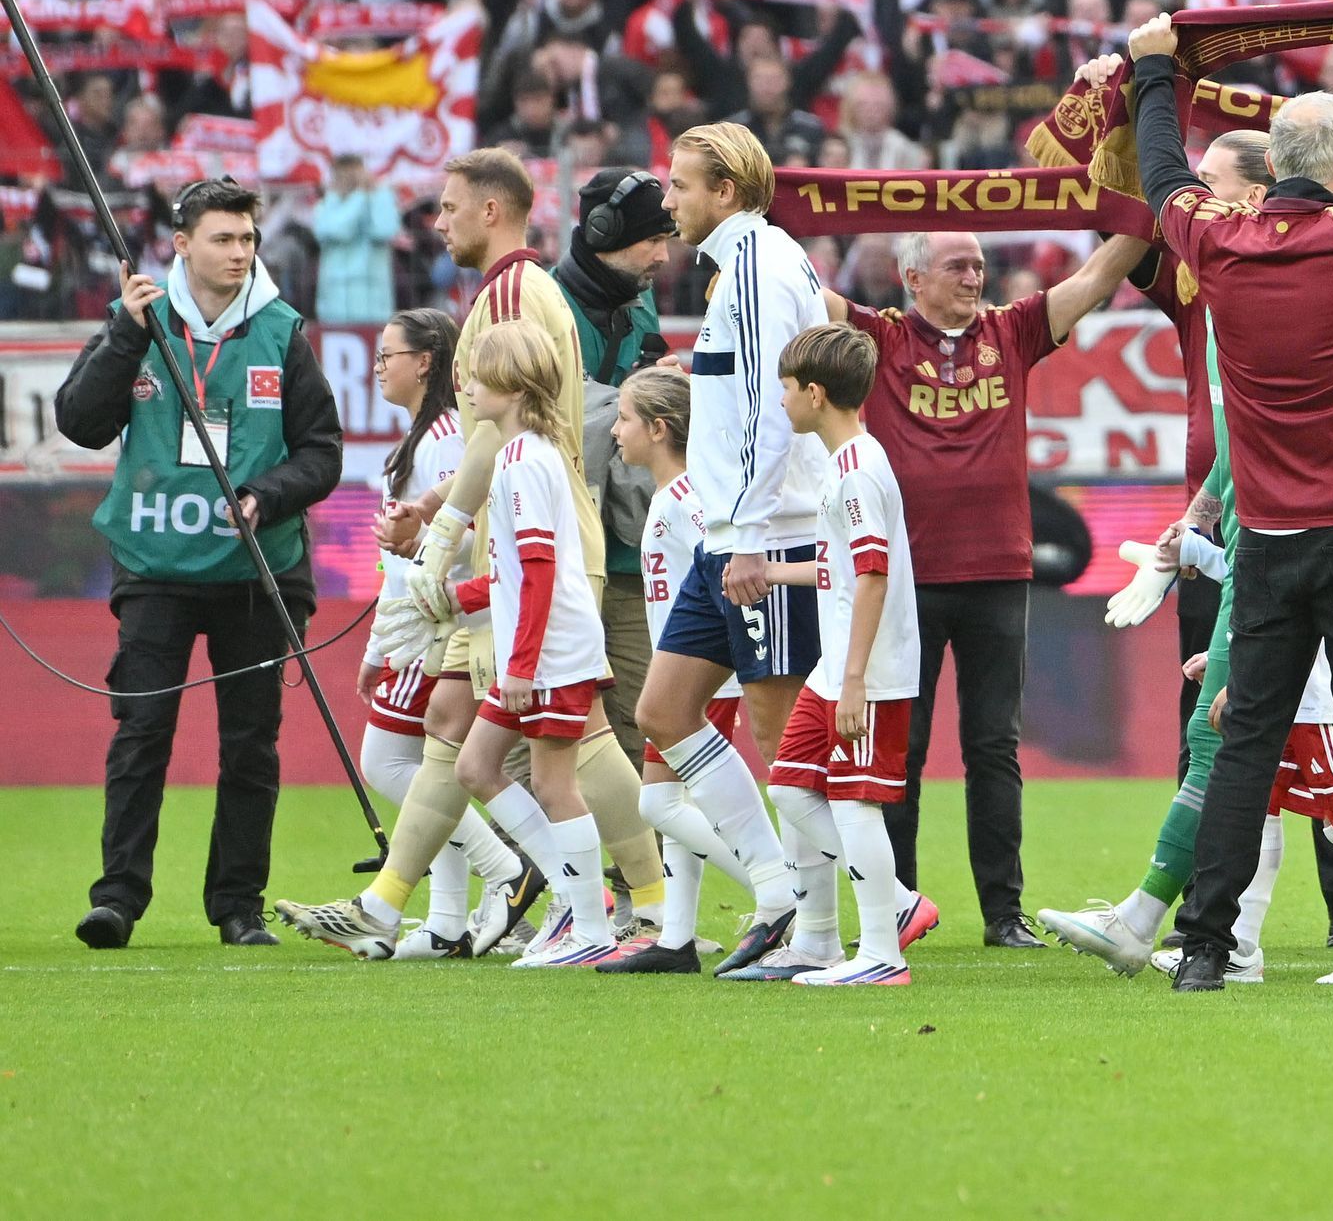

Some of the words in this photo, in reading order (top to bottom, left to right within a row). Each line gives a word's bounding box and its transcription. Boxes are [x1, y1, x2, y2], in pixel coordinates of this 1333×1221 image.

[798, 183, 837, 213] 1.
[846, 180, 926, 212] FC
[936, 170, 1100, 211] KÖLN
[909, 375, 1011, 419] REWE
[130, 491, 241, 537] HOS
[845, 499, 857, 527] CLUB
[852, 497, 863, 525] PÄNZ
[740, 598, 766, 643] 5
